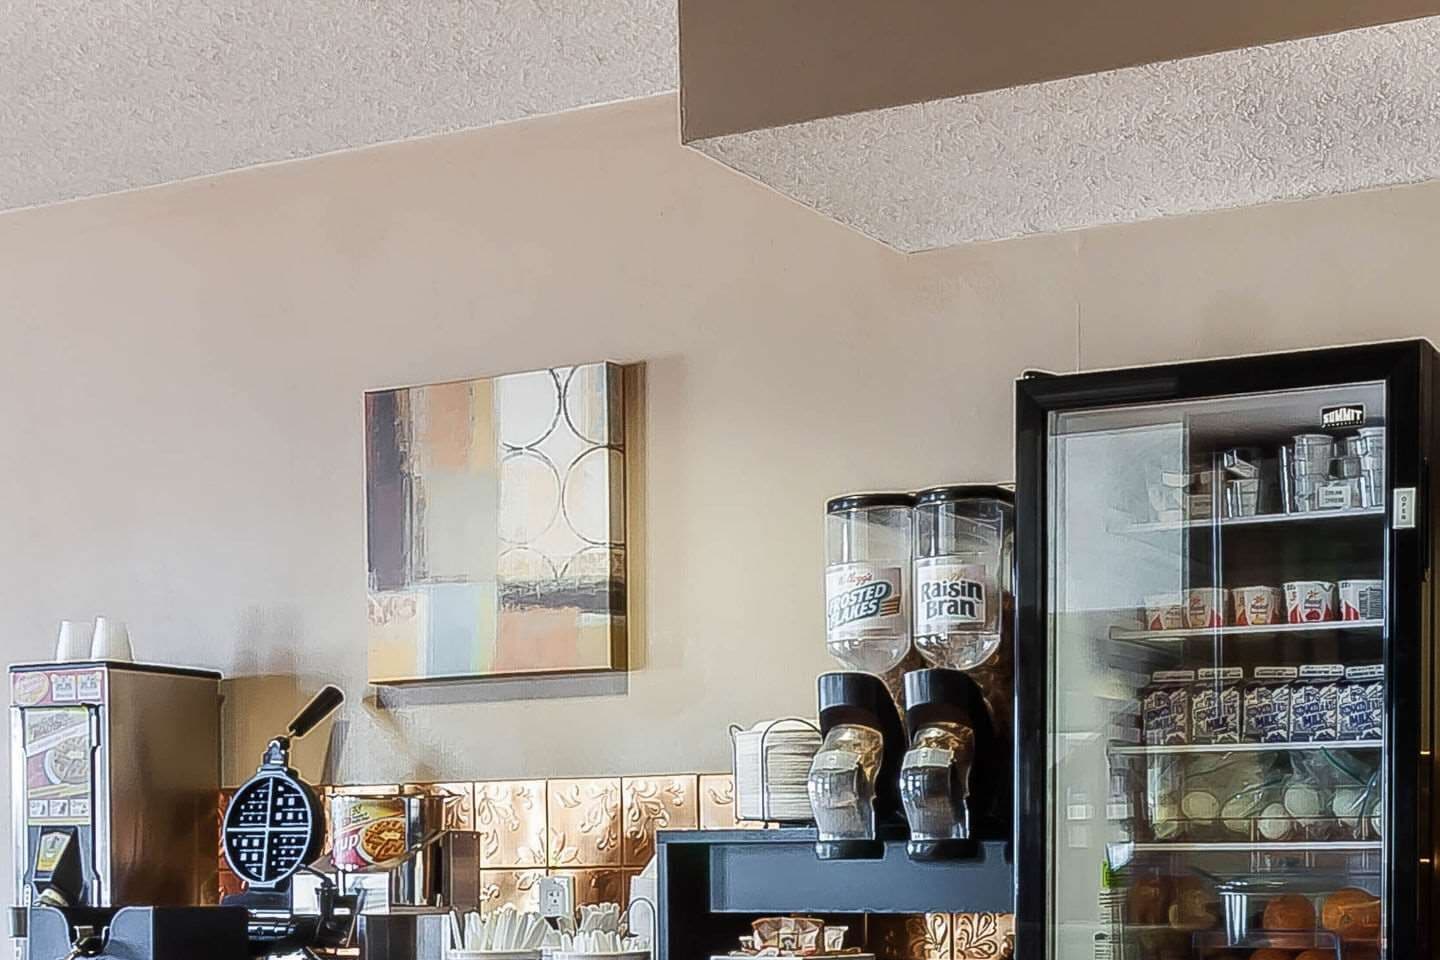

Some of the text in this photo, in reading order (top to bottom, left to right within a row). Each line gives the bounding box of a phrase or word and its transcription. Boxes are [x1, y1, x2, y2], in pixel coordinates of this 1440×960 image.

[1323, 407, 1362, 424] SUMMIT
[921, 580, 983, 601] Raisin
[926, 601, 977, 620] Bran
